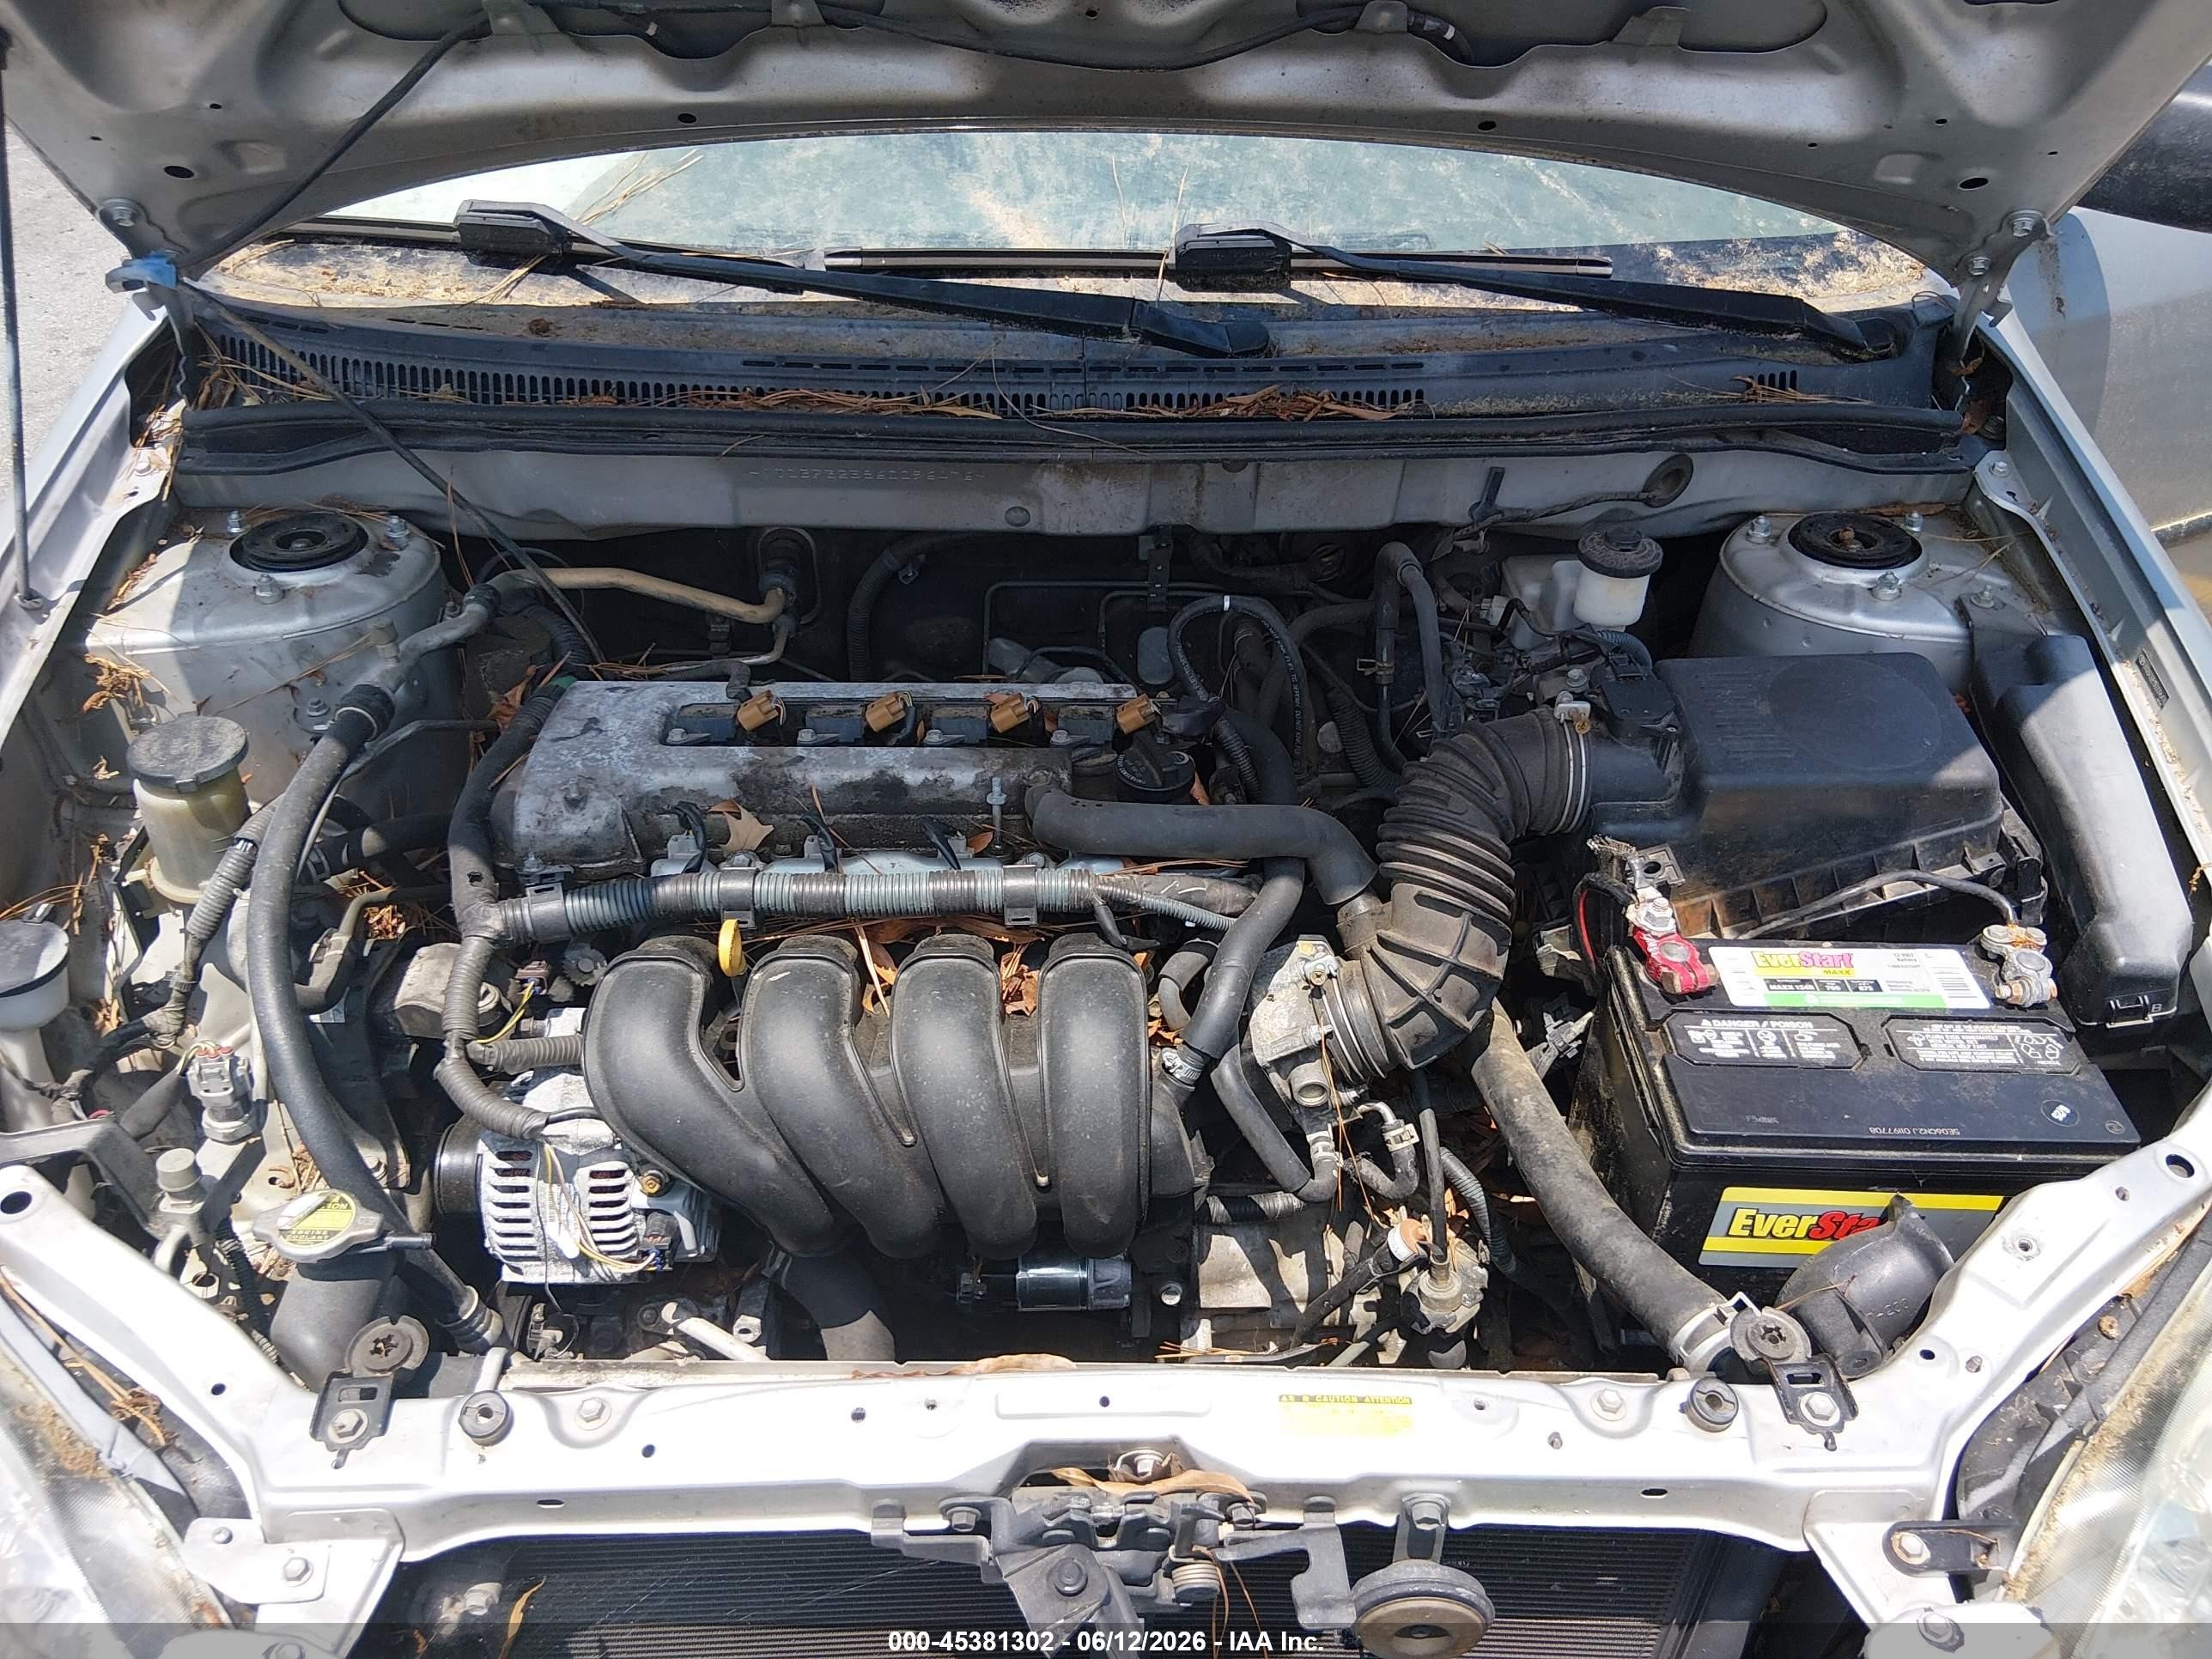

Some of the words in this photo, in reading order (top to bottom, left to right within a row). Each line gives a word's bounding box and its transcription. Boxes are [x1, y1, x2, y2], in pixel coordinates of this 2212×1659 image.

[1751, 951, 1853, 968] EverStart
[2152, 1003, 2162, 1012] B
[1711, 1019, 1759, 1028] DANGER
[1770, 1020, 1814, 1029] POISON
[1728, 1208, 1881, 1241] EverSta
[1316, 1395, 1358, 1403] CAUTION
[1364, 1395, 1410, 1405] ATTENTION
